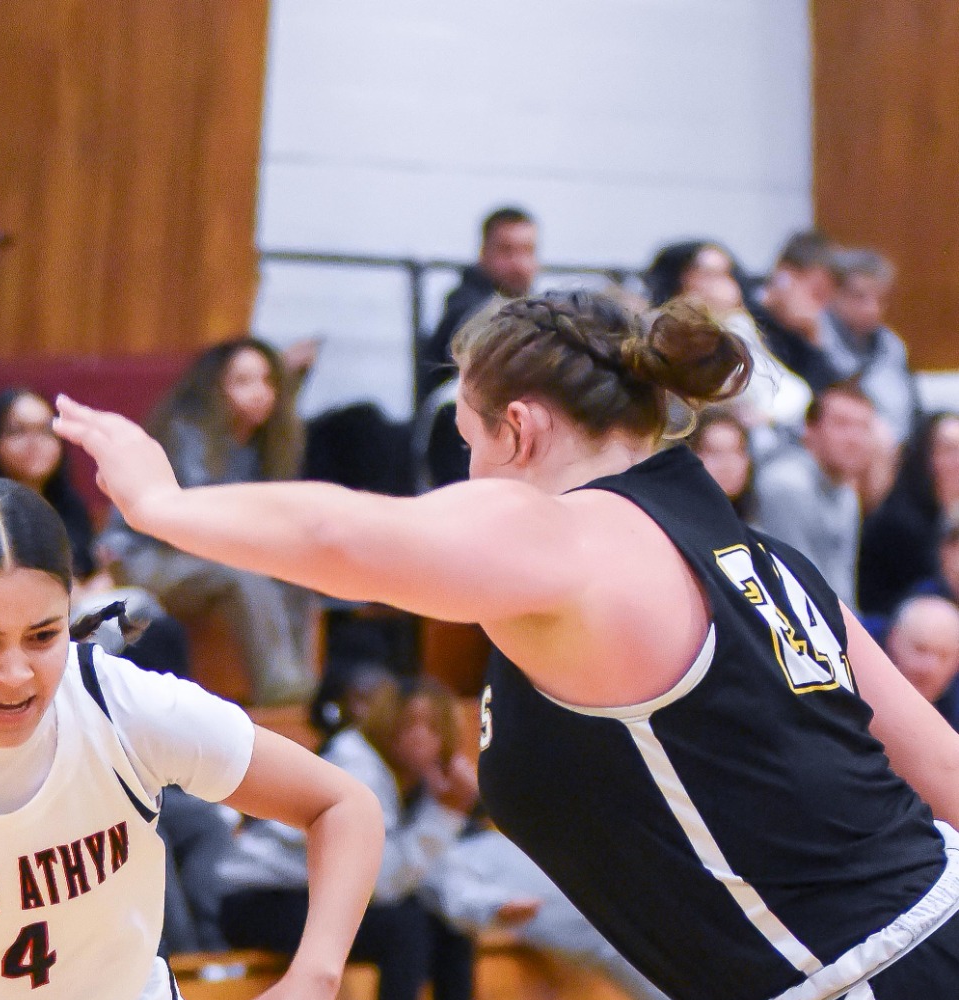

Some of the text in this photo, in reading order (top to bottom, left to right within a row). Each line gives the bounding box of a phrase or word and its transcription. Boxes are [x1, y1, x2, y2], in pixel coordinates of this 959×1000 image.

[712, 543, 857, 695] 24
[18, 821, 129, 911] ATHYN
[1, 921, 57, 990] 4
